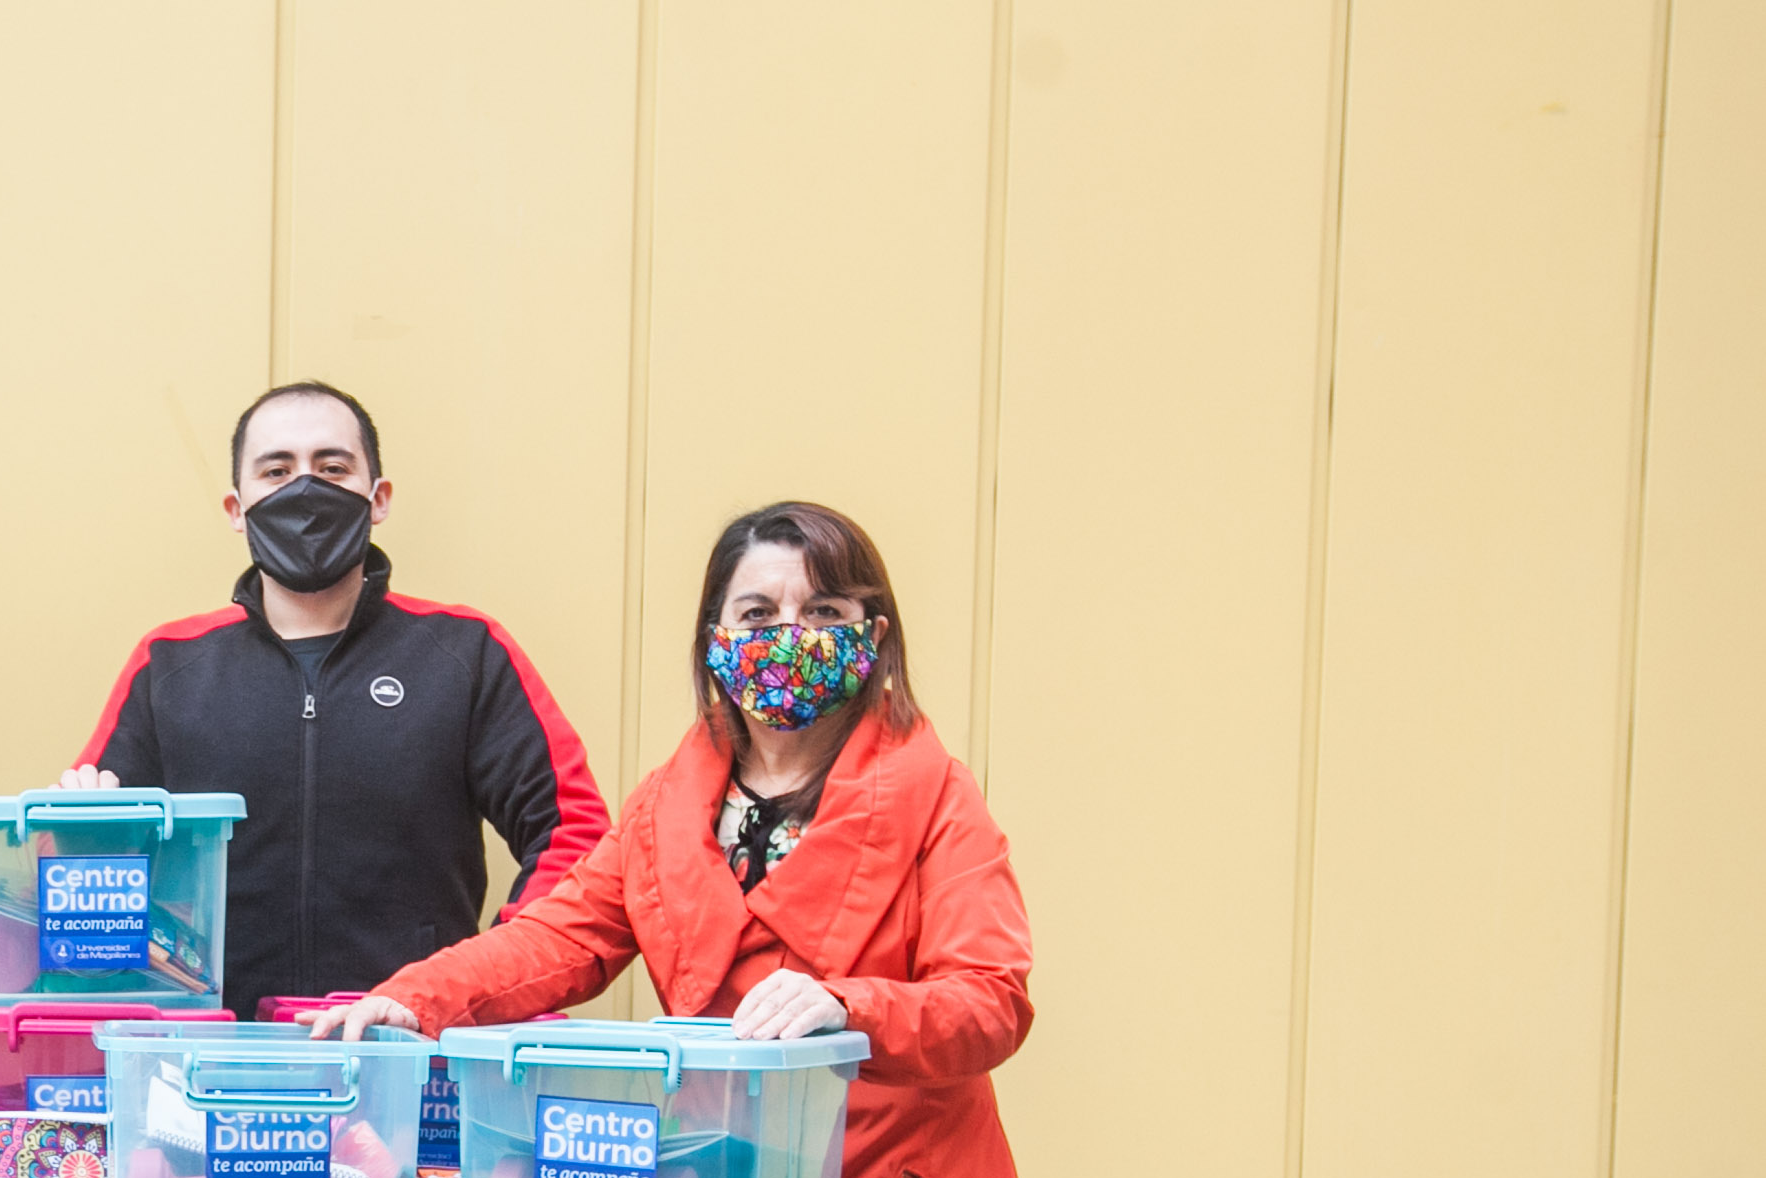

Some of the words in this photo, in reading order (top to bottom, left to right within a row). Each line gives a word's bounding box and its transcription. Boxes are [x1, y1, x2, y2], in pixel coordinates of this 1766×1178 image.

[45, 865, 146, 889] Centro
[47, 884, 147, 911] Diurno
[46, 918, 60, 931] te
[64, 915, 144, 933] acompaña
[34, 1084, 106, 1107] Cent
[544, 1105, 654, 1137] Centro
[215, 1124, 327, 1150] Diurno
[543, 1129, 653, 1166] Diurno
[213, 1158, 230, 1172] te
[234, 1157, 325, 1175] acompaña
